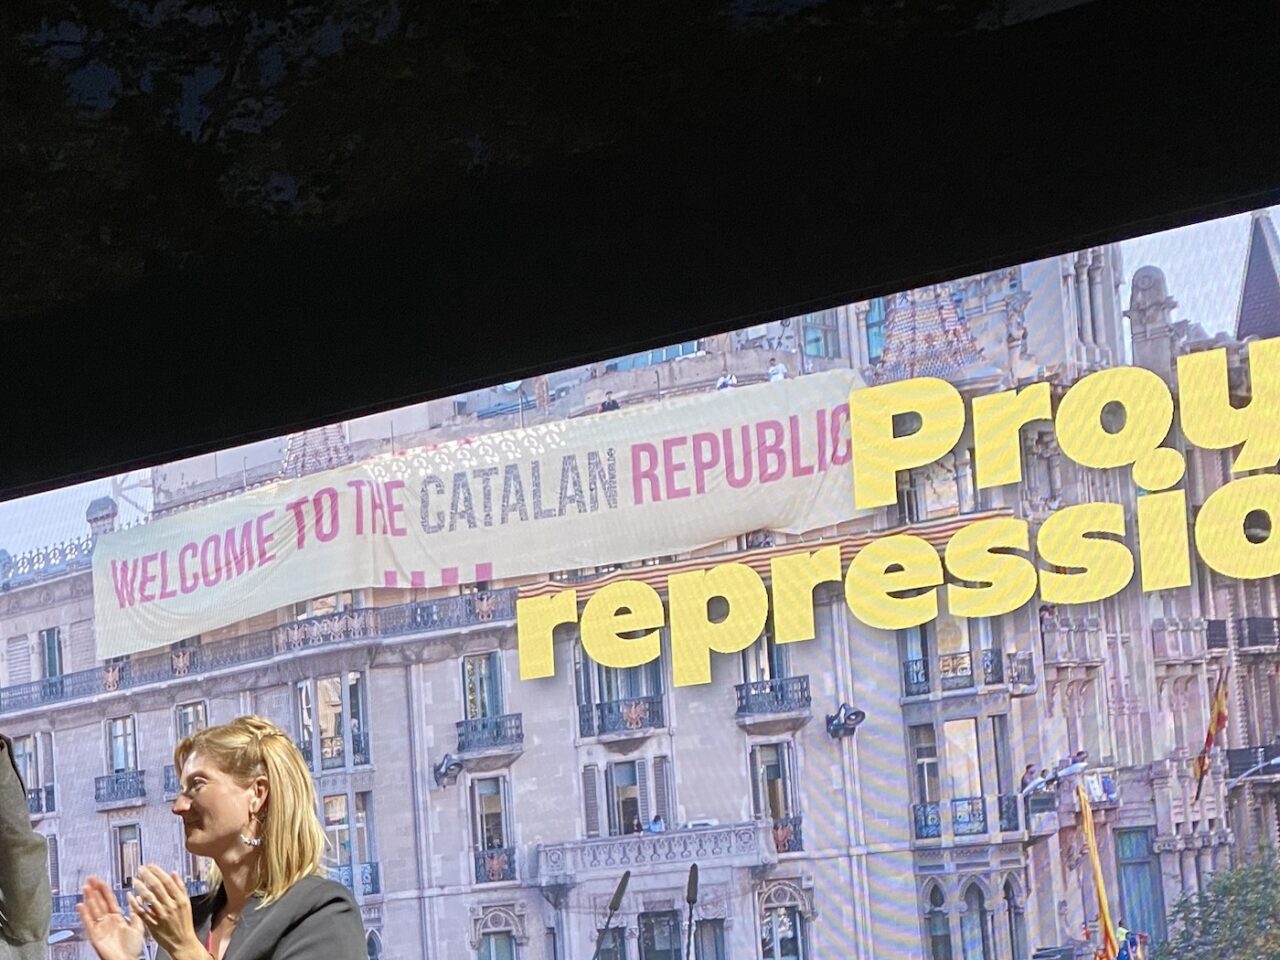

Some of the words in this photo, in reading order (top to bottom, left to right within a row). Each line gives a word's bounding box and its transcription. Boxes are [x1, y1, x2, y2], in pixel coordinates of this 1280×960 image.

[111, 510, 276, 609] WELCOME
[286, 487, 340, 550] TO
[347, 480, 408, 537] THE
[419, 450, 618, 535] CATALAN
[631, 403, 852, 506] REPUBLIC
